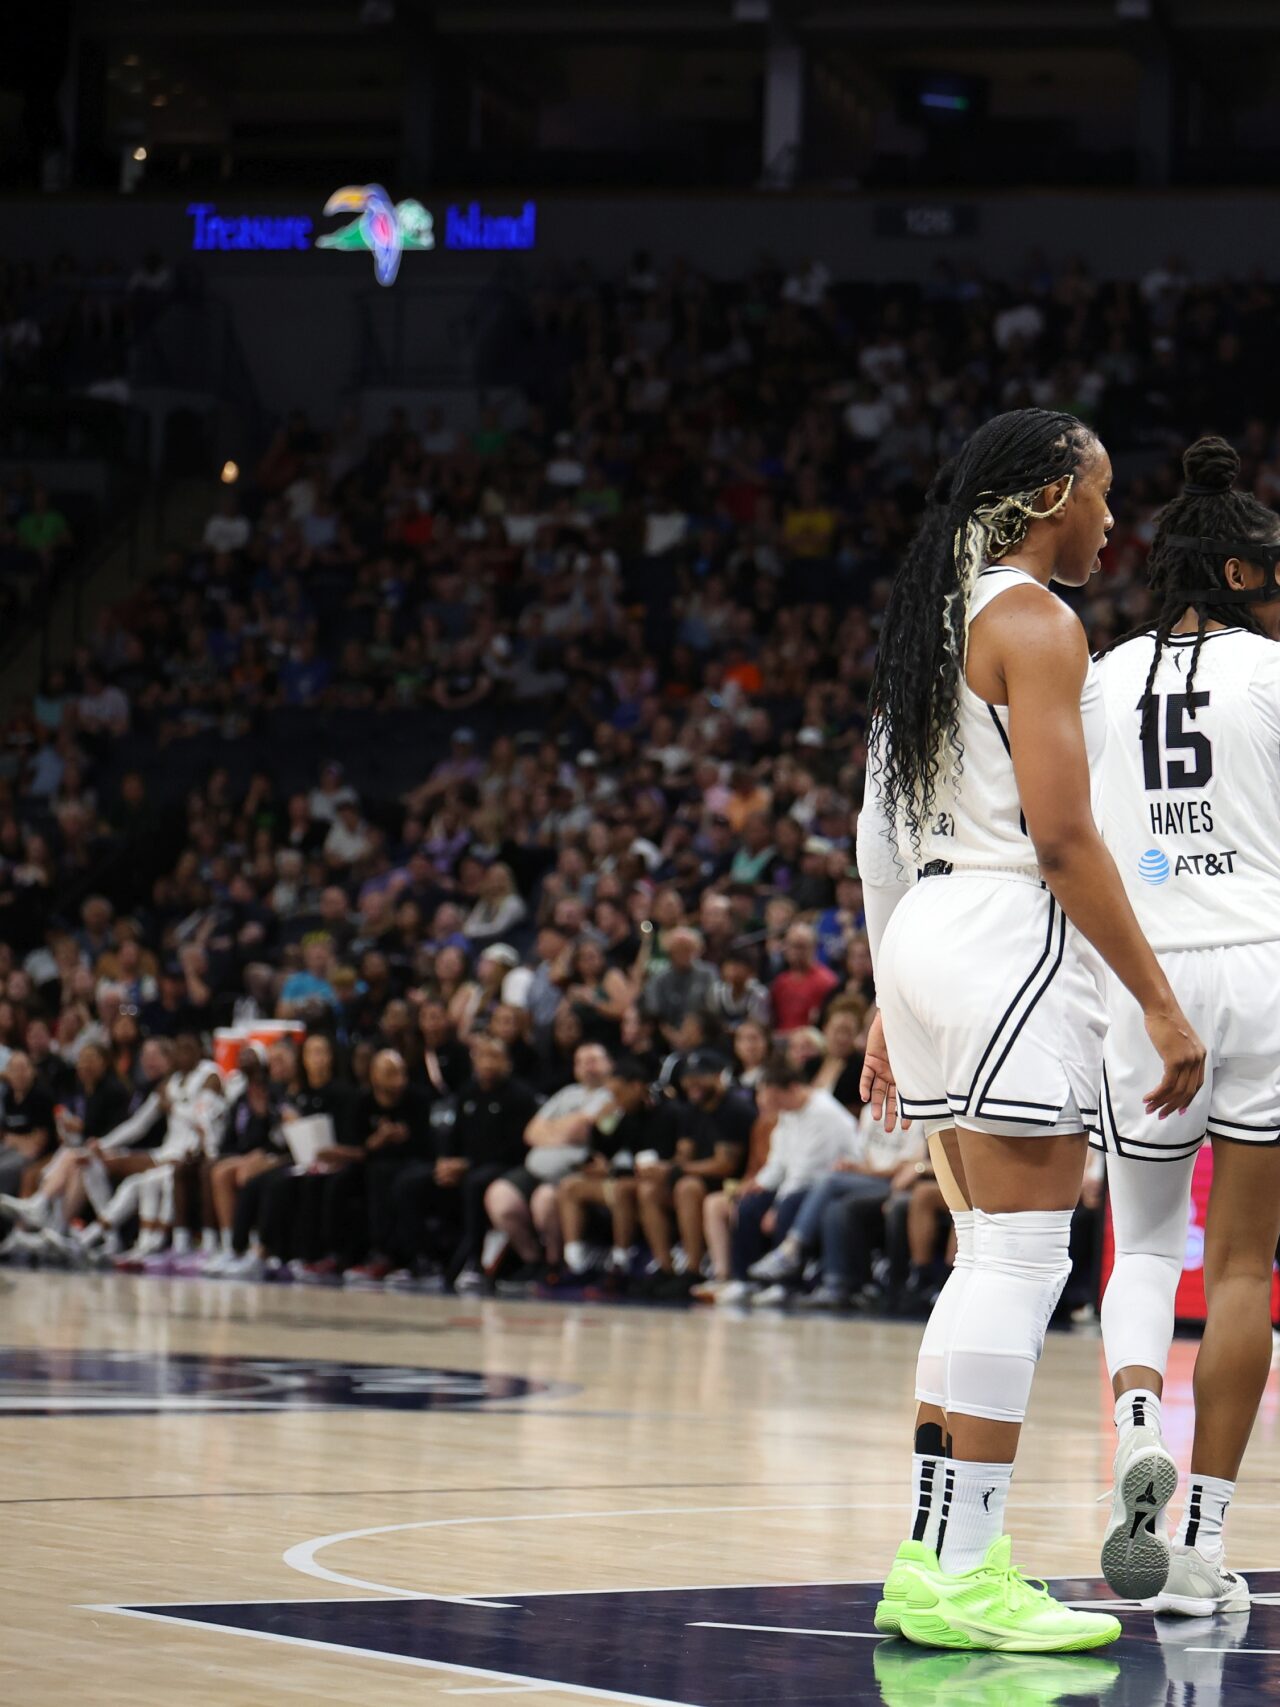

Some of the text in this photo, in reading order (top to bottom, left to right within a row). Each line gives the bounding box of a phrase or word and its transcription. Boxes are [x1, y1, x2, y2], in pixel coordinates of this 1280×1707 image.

[187, 200, 536, 251] Treasure Island
[1136, 690, 1213, 790] 15
[1149, 800, 1214, 835] HAYES
[1174, 850, 1238, 877] AT&T
